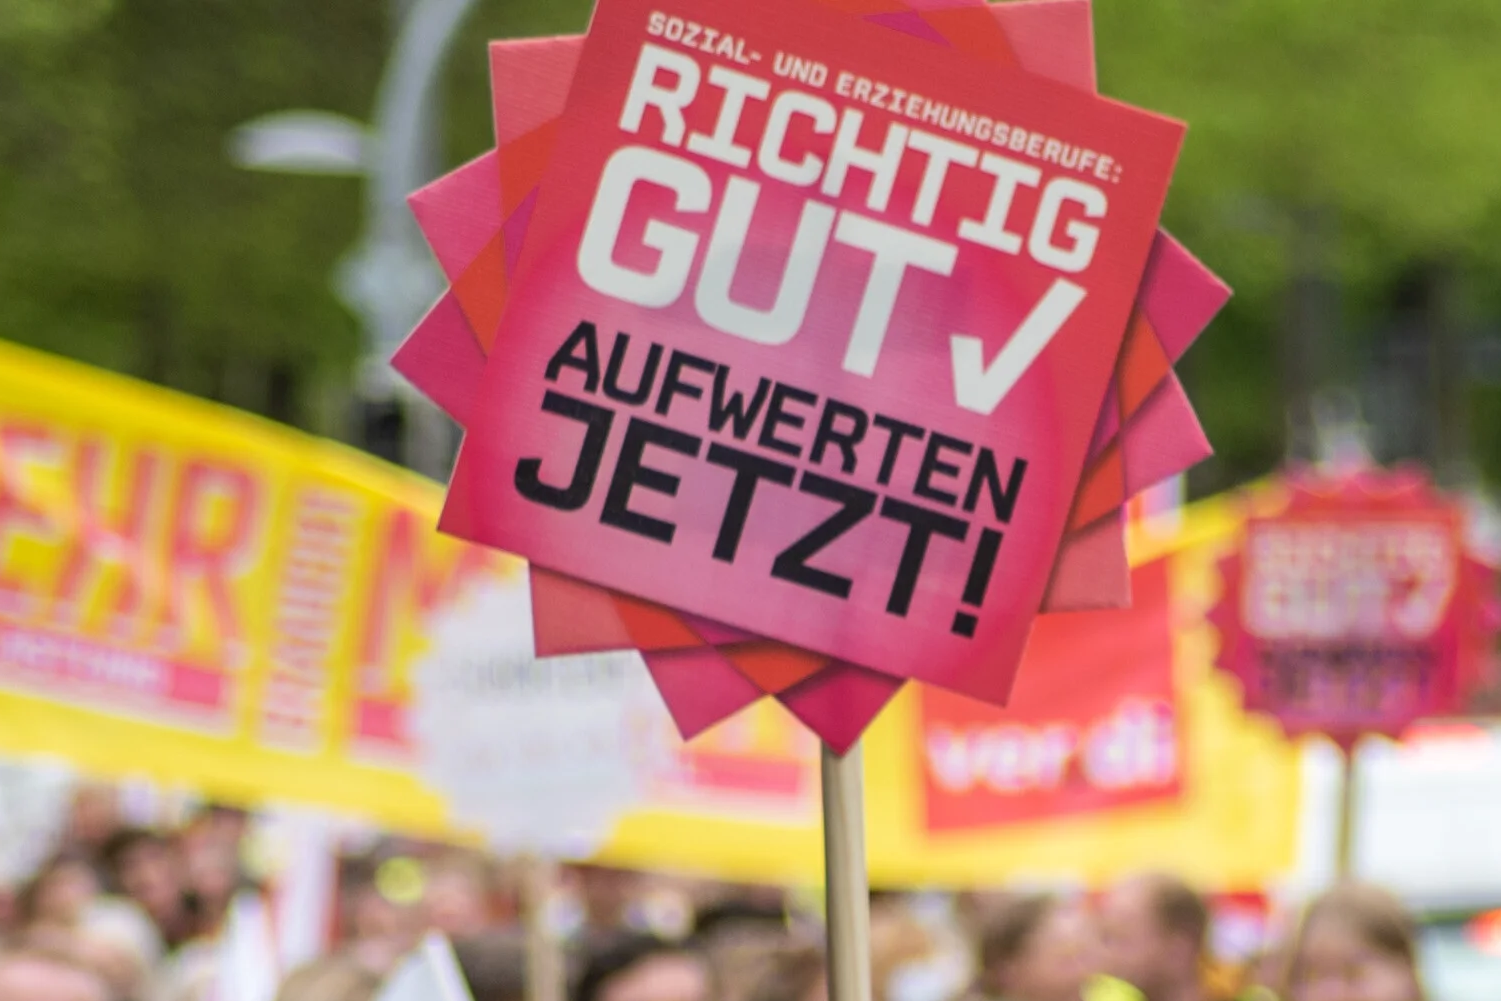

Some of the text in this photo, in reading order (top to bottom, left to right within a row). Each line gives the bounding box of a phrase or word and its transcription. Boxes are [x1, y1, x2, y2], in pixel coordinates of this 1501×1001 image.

[618, 42, 1108, 273] RICHTIG
[647, 12, 1123, 183] SOZIAL- UND ERZIEHUNGSBERUFE:
[576, 144, 958, 378] GUT
[513, 389, 1004, 640] JETZT!
[544, 320, 1027, 524] AUFWERTEN
